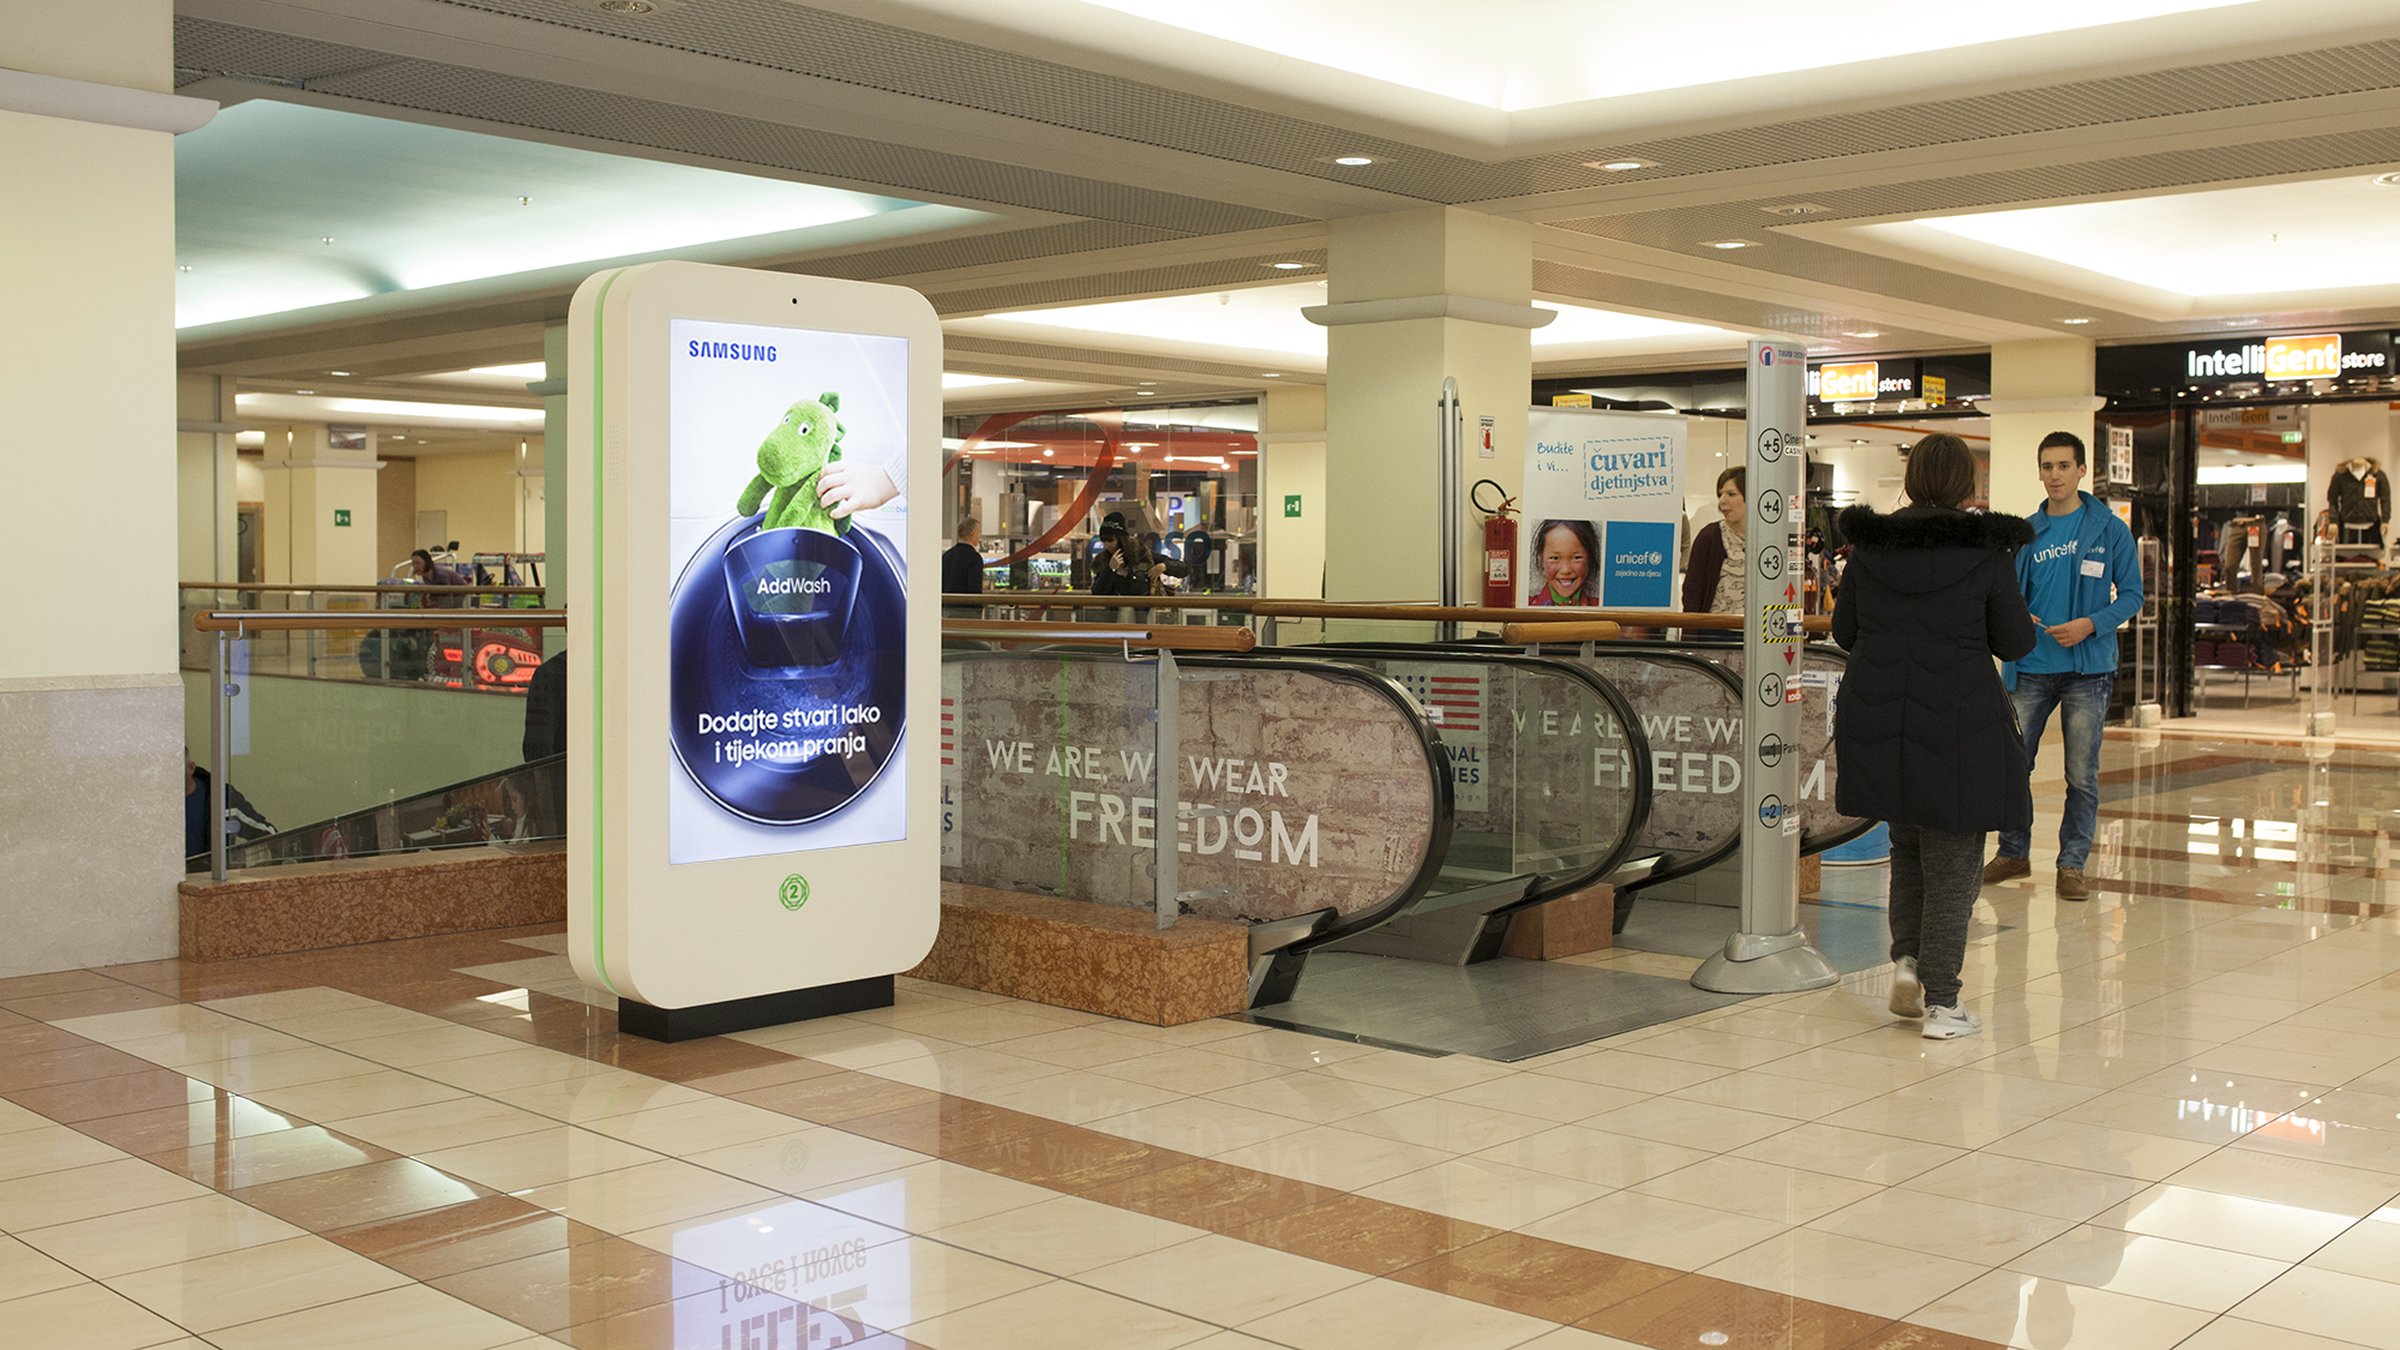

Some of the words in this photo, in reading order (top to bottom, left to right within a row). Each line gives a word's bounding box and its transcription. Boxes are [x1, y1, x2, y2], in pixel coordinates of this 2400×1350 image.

[689, 340, 777, 362] SAMSUNG
[2188, 344, 2338, 377] IntelliGent
[2342, 351, 2386, 369] store
[1879, 377, 1912, 392] store
[2209, 411, 2270, 424] IntelliGent
[1537, 442, 1574, 456] Budite
[1764, 438, 1780, 453] +5
[1591, 443, 1667, 471] čuvari
[1537, 460, 1541, 471] i
[1591, 473, 1668, 495] djetinjstva
[1764, 499, 1780, 514] +4
[1615, 551, 1649, 564] unicef
[2033, 540, 2072, 563] unicef
[1764, 555, 1780, 570] +3
[1646, 570, 1661, 578] djecu
[757, 577, 831, 594] AddWash
[1773, 617, 1785, 630] +2
[1764, 683, 1779, 698] +1
[698, 712, 778, 737] Dodajte
[782, 705, 838, 729] stvari
[841, 703, 881, 725] lako
[1511, 709, 1558, 735] WE
[1642, 714, 1692, 743] WE
[715, 743, 720, 762] i
[725, 740, 799, 767] tijekom
[803, 733, 866, 761] pranja
[986, 739, 1034, 774] WE
[1046, 747, 1108, 783] ARE,
[1188, 756, 1288, 797] WEAR
[1594, 747, 1826, 801] FREEDM
[1764, 803, 1777, 819] -2
[1069, 790, 1319, 868] FREEDOM
